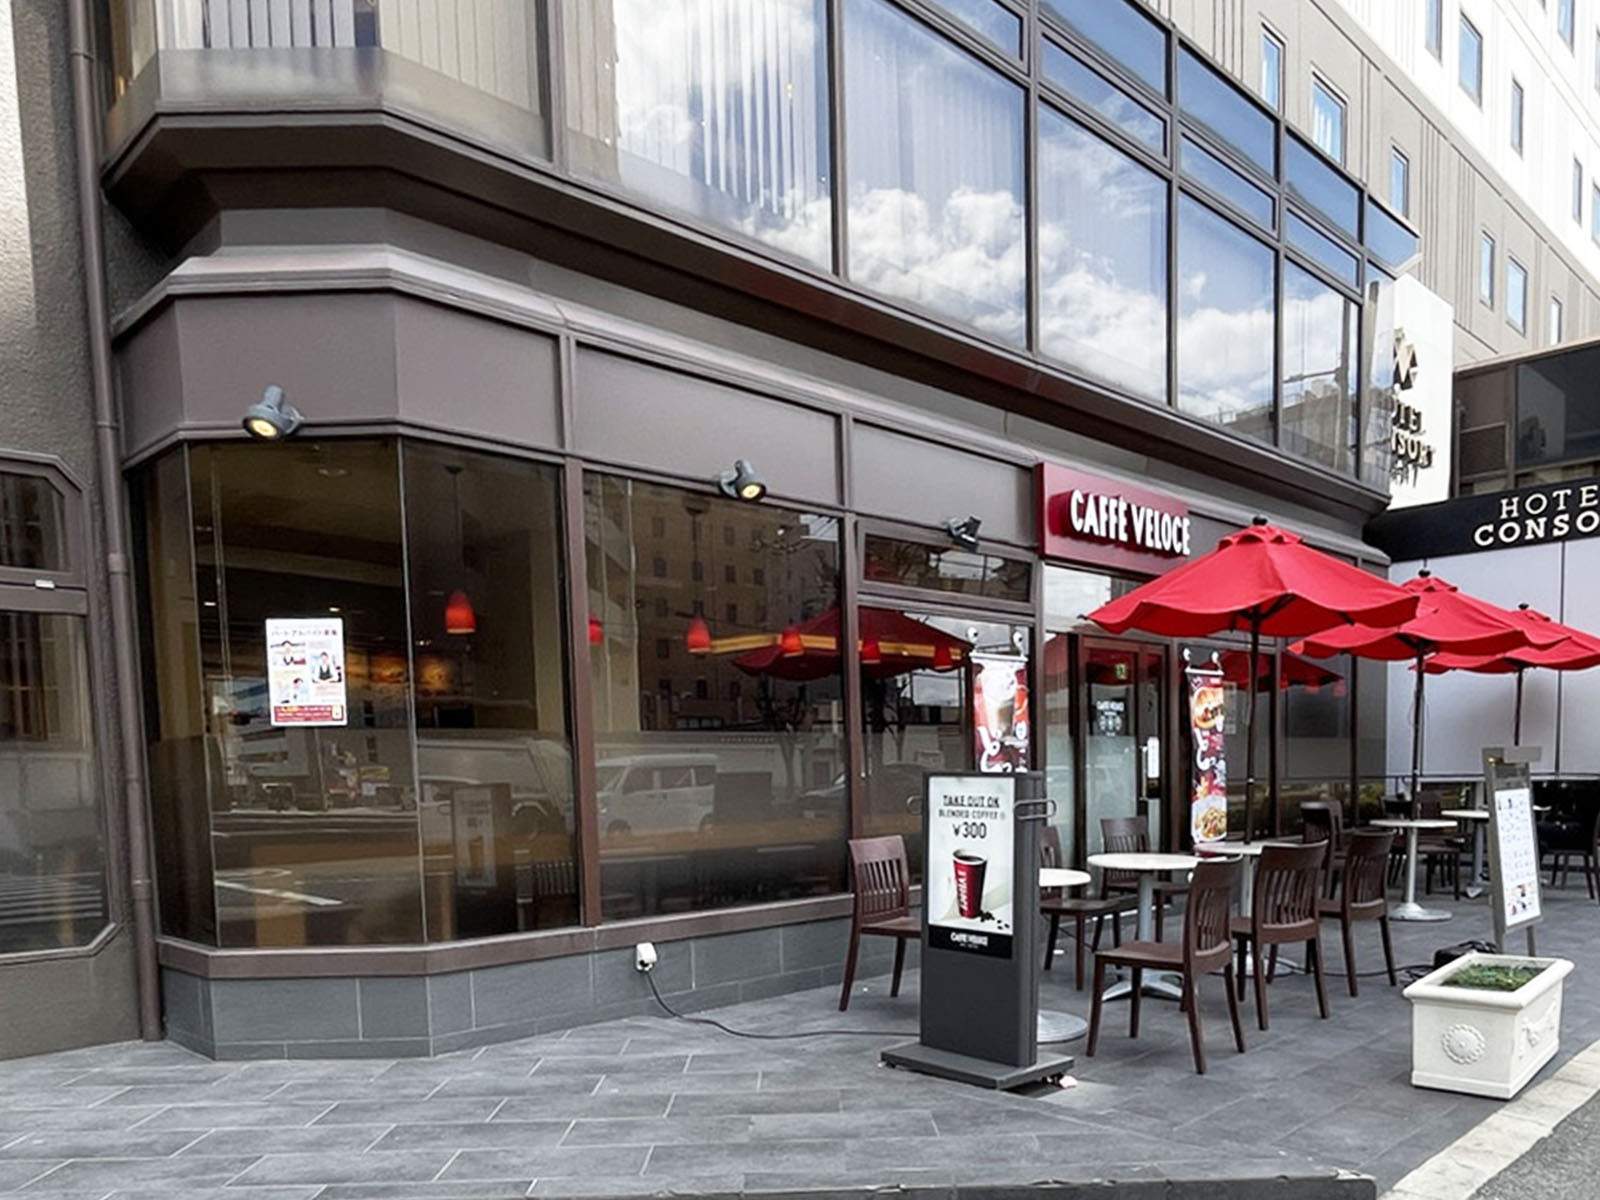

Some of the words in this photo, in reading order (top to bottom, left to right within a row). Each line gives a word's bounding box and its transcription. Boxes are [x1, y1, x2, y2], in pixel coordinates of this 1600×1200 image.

[1500, 485, 1599, 519] HOTE
[1130, 503, 1190, 555] VELOCE
[1474, 510, 1600, 546] CONSO
[938, 809, 969, 819] BLENDED
[972, 810, 998, 819] COFFEE
[943, 795, 965, 807] TAKE
[967, 796, 985, 808] OUT
[987, 796, 1000, 809] OK
